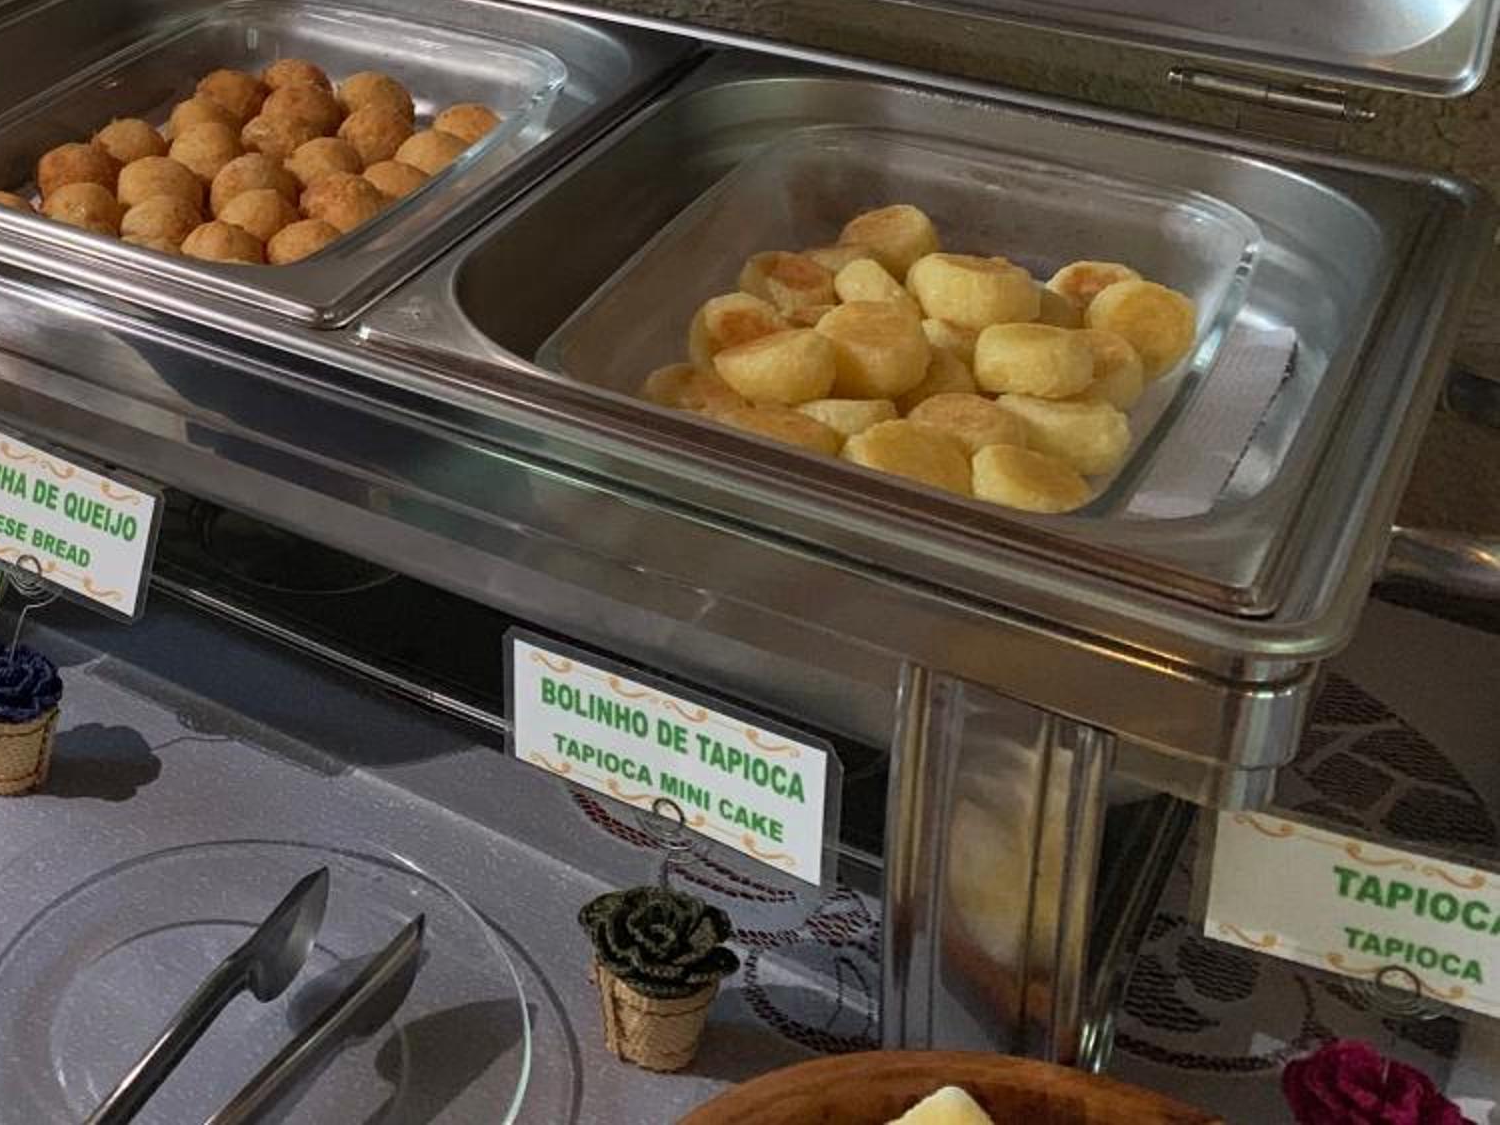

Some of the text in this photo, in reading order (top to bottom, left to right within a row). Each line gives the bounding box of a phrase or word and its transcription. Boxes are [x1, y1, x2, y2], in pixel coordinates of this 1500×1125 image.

[32, 478, 60, 511] DE
[63, 492, 138, 542] QUEIJO
[31, 528, 92, 568] BREAD
[540, 677, 806, 804] BOLINHO DE TAPIOCA
[551, 732, 785, 844] TAPIOCA MINI CAKE
[1343, 926, 1485, 985] TAPIOCA
